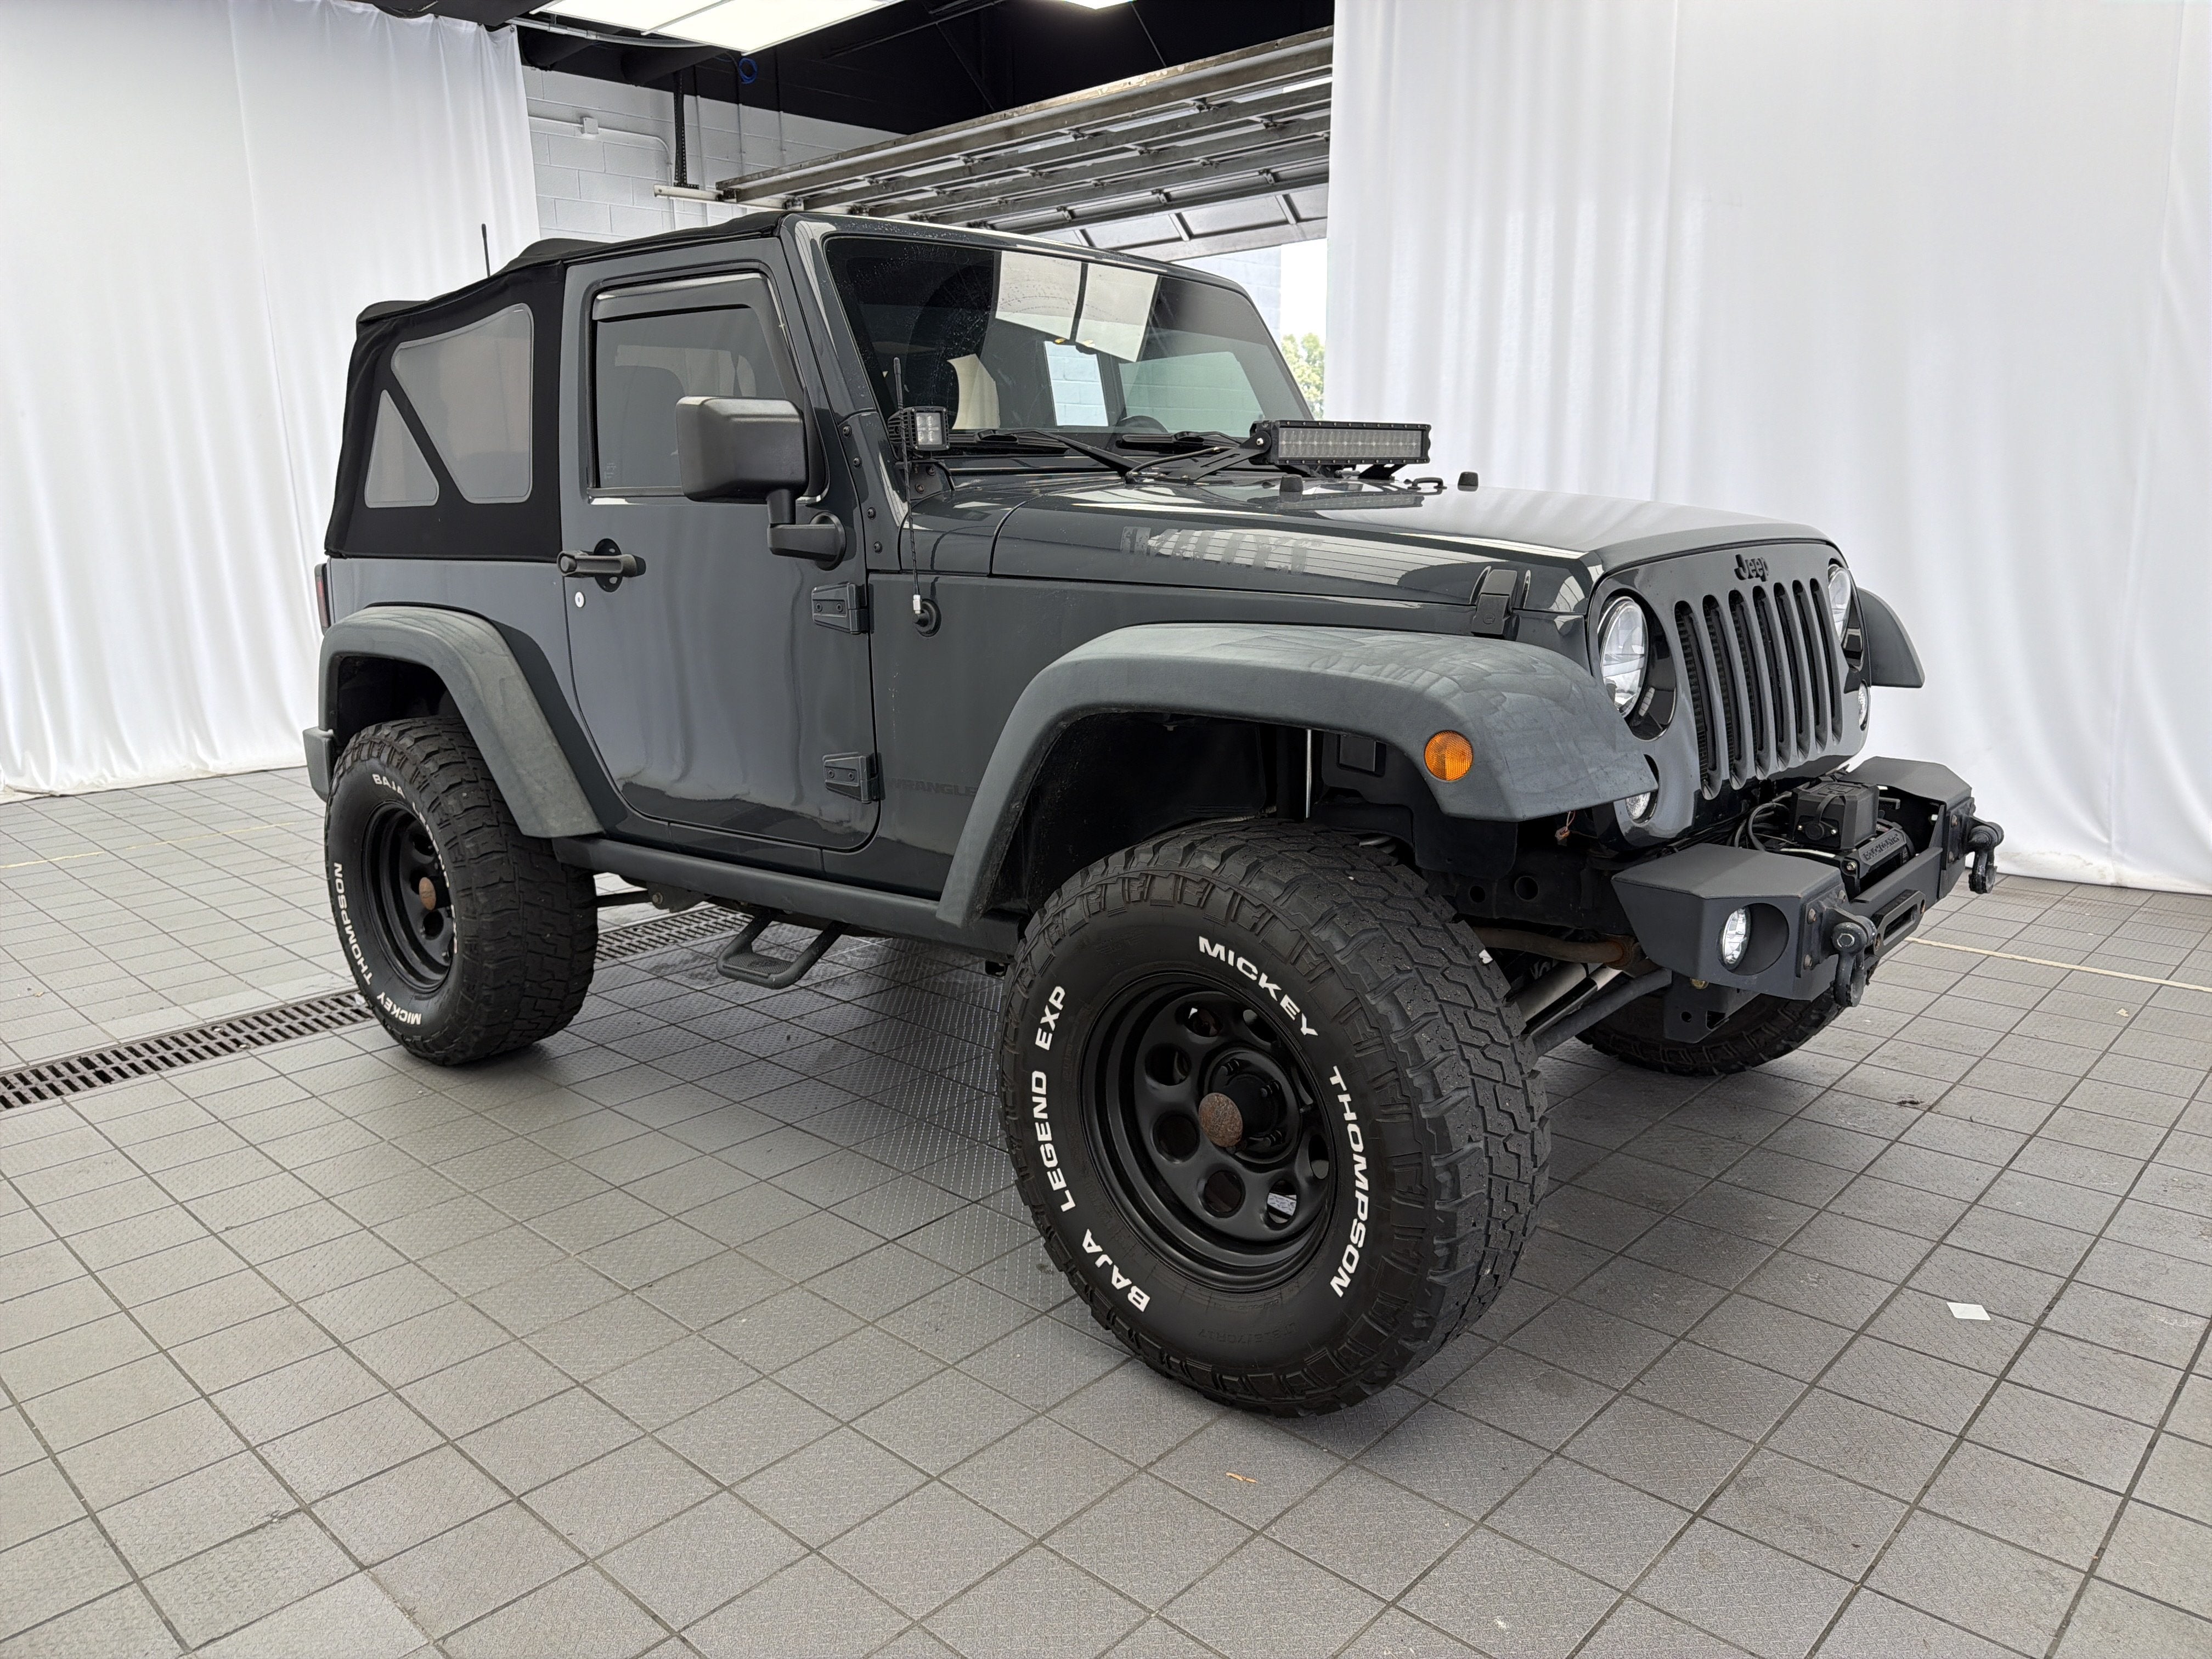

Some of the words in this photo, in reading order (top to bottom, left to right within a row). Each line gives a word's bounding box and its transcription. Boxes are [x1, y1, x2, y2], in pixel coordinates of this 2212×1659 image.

[1734, 554, 1769, 582] Jeep
[371, 773, 406, 799] BAJA
[334, 862, 373, 986] THOMPSON
[376, 991, 422, 1025] MICKEY
[1035, 986, 1066, 1051] EXP
[1031, 1070, 1076, 1212] LEGEND
[1199, 936, 1318, 1036] MICKEY
[1329, 1065, 1369, 1298] THOMPSON
[1082, 1228, 1150, 1312] BAJA
